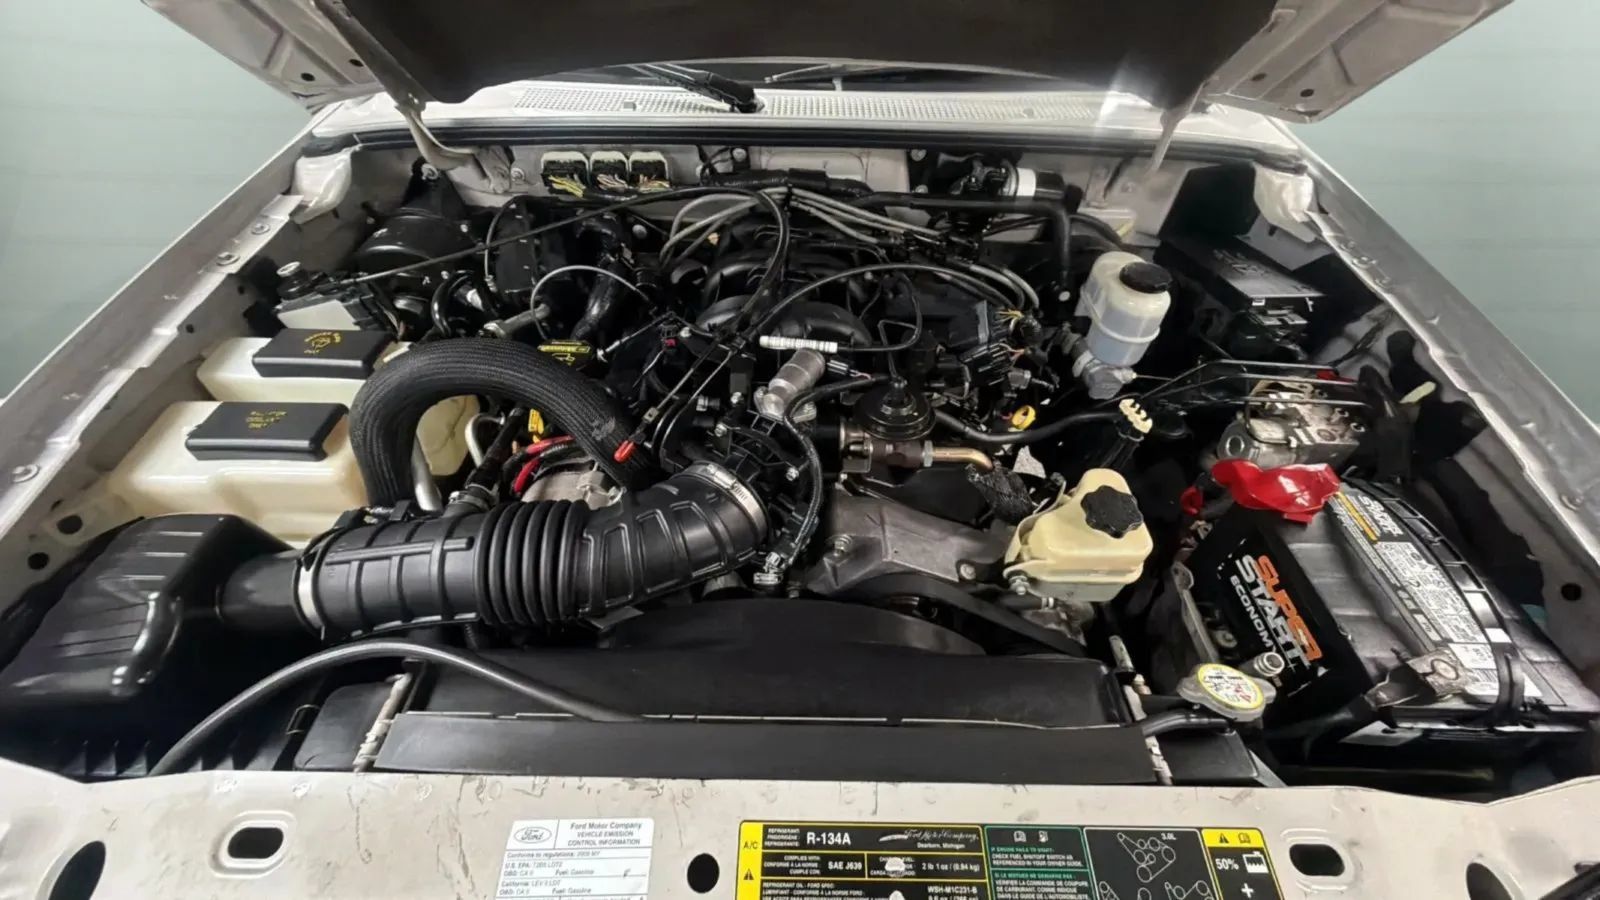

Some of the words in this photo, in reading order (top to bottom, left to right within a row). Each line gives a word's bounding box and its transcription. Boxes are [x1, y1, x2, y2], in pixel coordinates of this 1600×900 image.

[1235, 555, 1312, 669] START
[1258, 555, 1323, 661] SUPER
[570, 822, 587, 830] Ford
[609, 821, 642, 830] Company
[521, 827, 545, 840] Ford
[806, 831, 851, 845] R-134A
[1160, 832, 1177, 840] 3.0L
[598, 838, 640, 846] INFORMATION
[743, 841, 759, 850] A/C
[828, 861, 843, 870] SAE
[845, 861, 863, 871] J639
[969, 864, 980, 872] kg)
[1215, 857, 1239, 870] 50%
